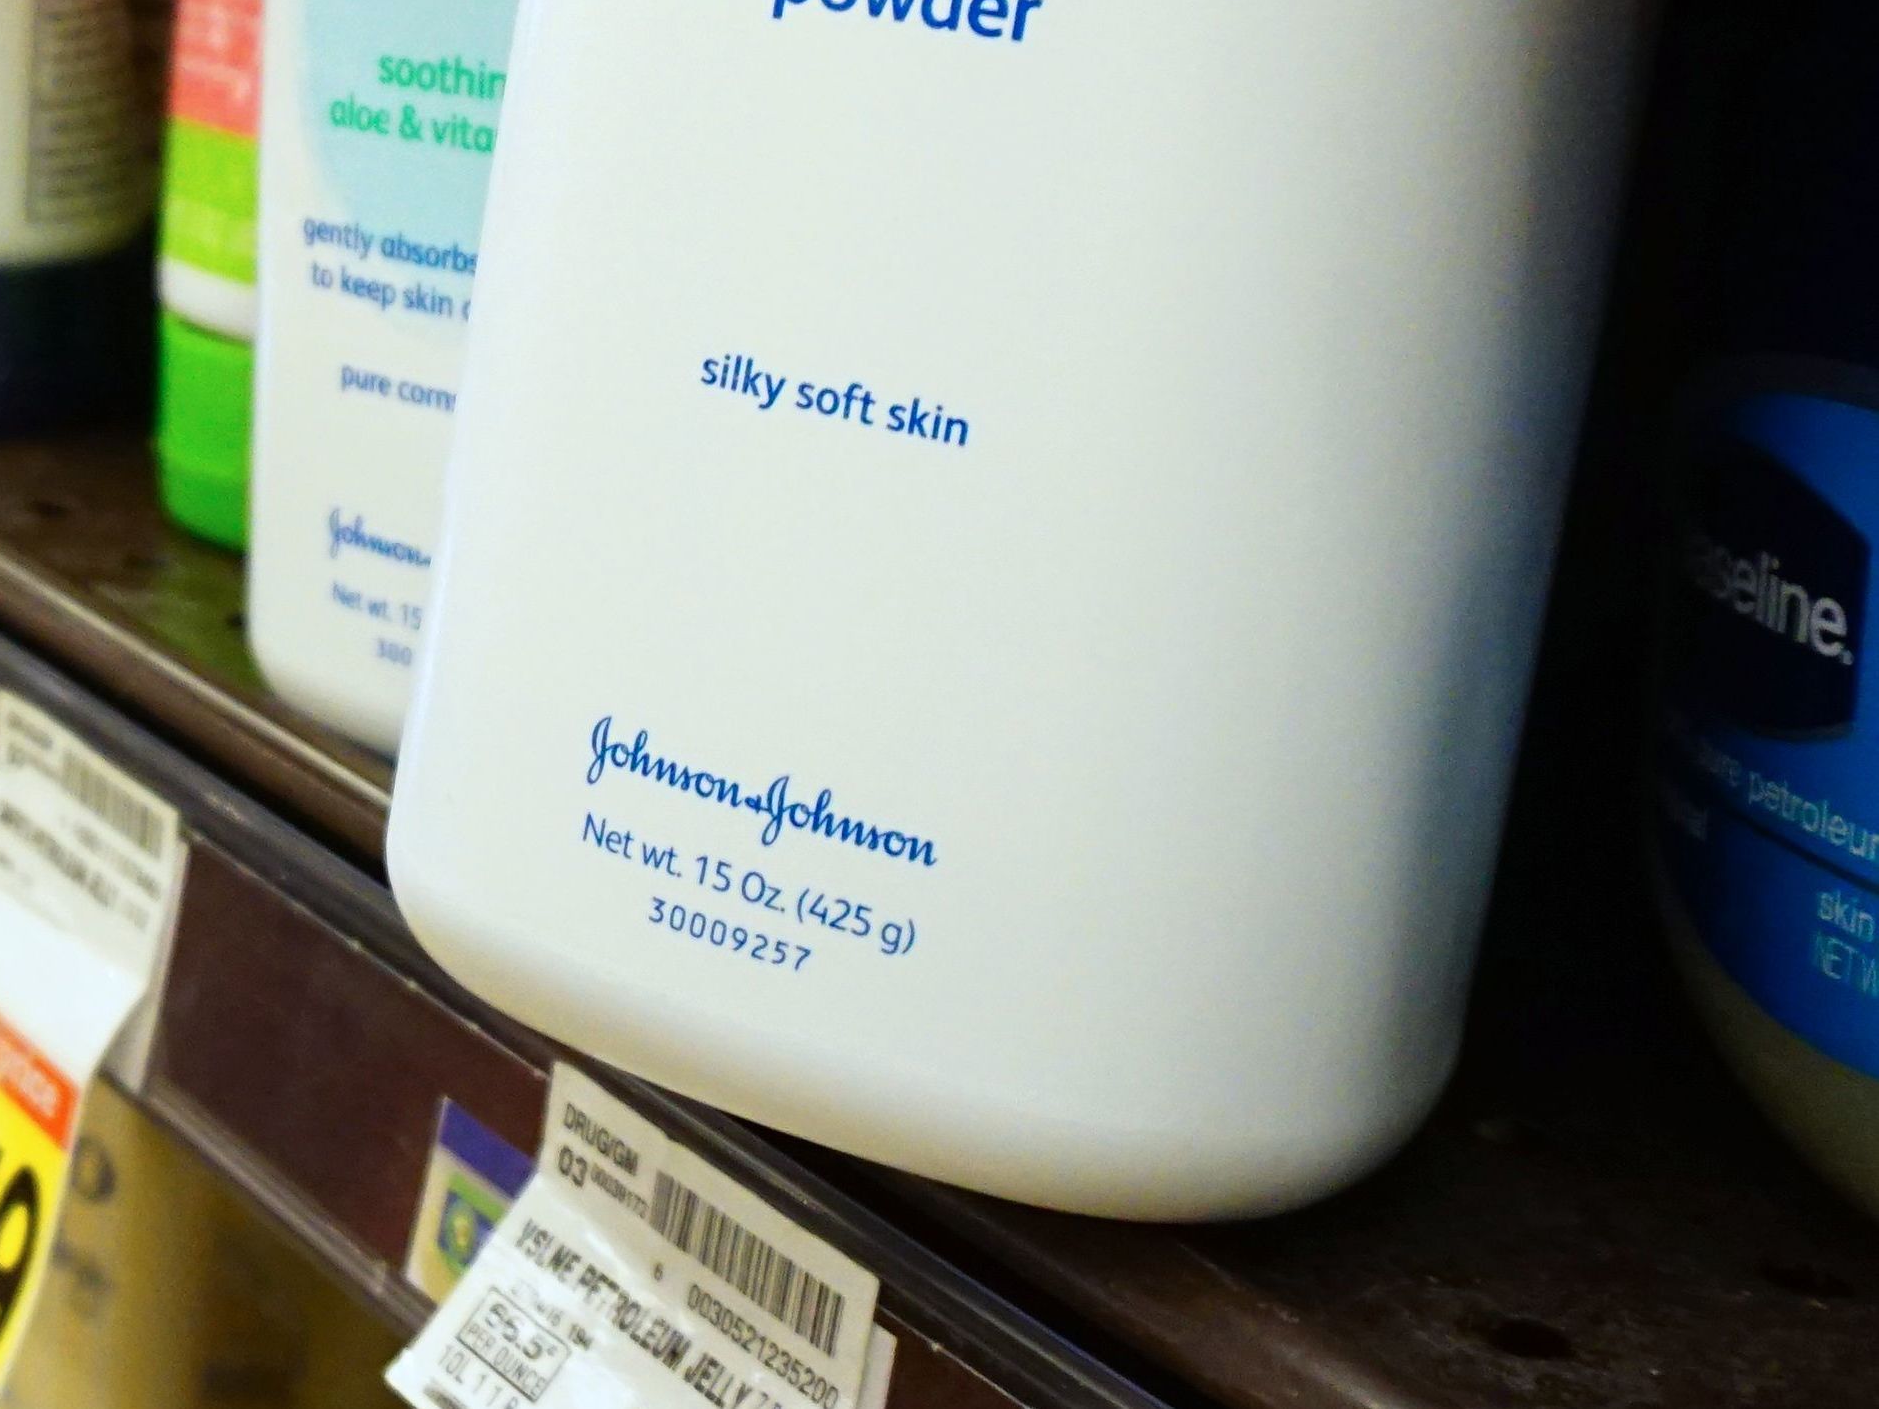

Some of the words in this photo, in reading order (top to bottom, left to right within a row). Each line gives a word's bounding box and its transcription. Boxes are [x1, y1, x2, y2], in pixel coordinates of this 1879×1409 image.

[377, 54, 507, 100] soothin
[329, 93, 391, 135] aloe
[397, 104, 421, 141] &
[430, 113, 498, 154] vita
[303, 215, 374, 260] gently
[310, 261, 334, 290] to
[339, 264, 398, 310] keep
[402, 283, 454, 319] skin
[340, 364, 393, 397] pure
[397, 377, 456, 414] corn
[701, 354, 787, 410] silky
[795, 382, 876, 426] soft
[886, 397, 970, 447] skin
[582, 812, 635, 860] Net
[641, 842, 683, 878] wt.
[694, 855, 733, 892] 15
[740, 871, 786, 913] Oz.
[796, 888, 873, 937] (425
[878, 919, 917, 957] g)
[648, 896, 813, 972] 30009257
[1816, 889, 1876, 947] skin
[559, 1145, 588, 1188] 03
[576, 1263, 693, 1373] PETROLEUM
[684, 1351, 753, 1409] JELLY
[687, 1284, 840, 1409] 0030521235200
[492, 1346, 548, 1397] OUNCE
